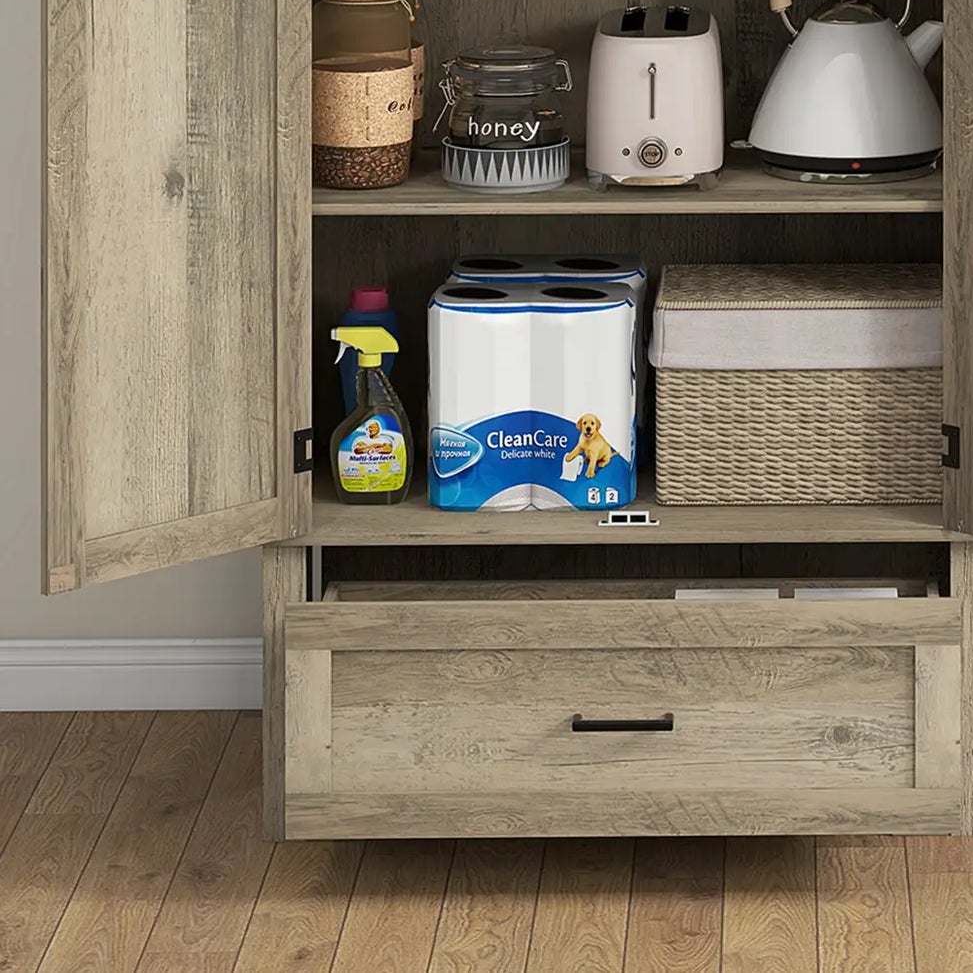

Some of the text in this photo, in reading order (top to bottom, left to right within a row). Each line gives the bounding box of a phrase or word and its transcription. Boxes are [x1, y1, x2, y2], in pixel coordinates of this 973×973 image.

[468, 117, 540, 142] honey
[486, 430, 568, 448] CleanCare
[441, 450, 471, 460] прочная
[501, 449, 556, 460] Delicate white
[610, 492, 614, 500] 2
